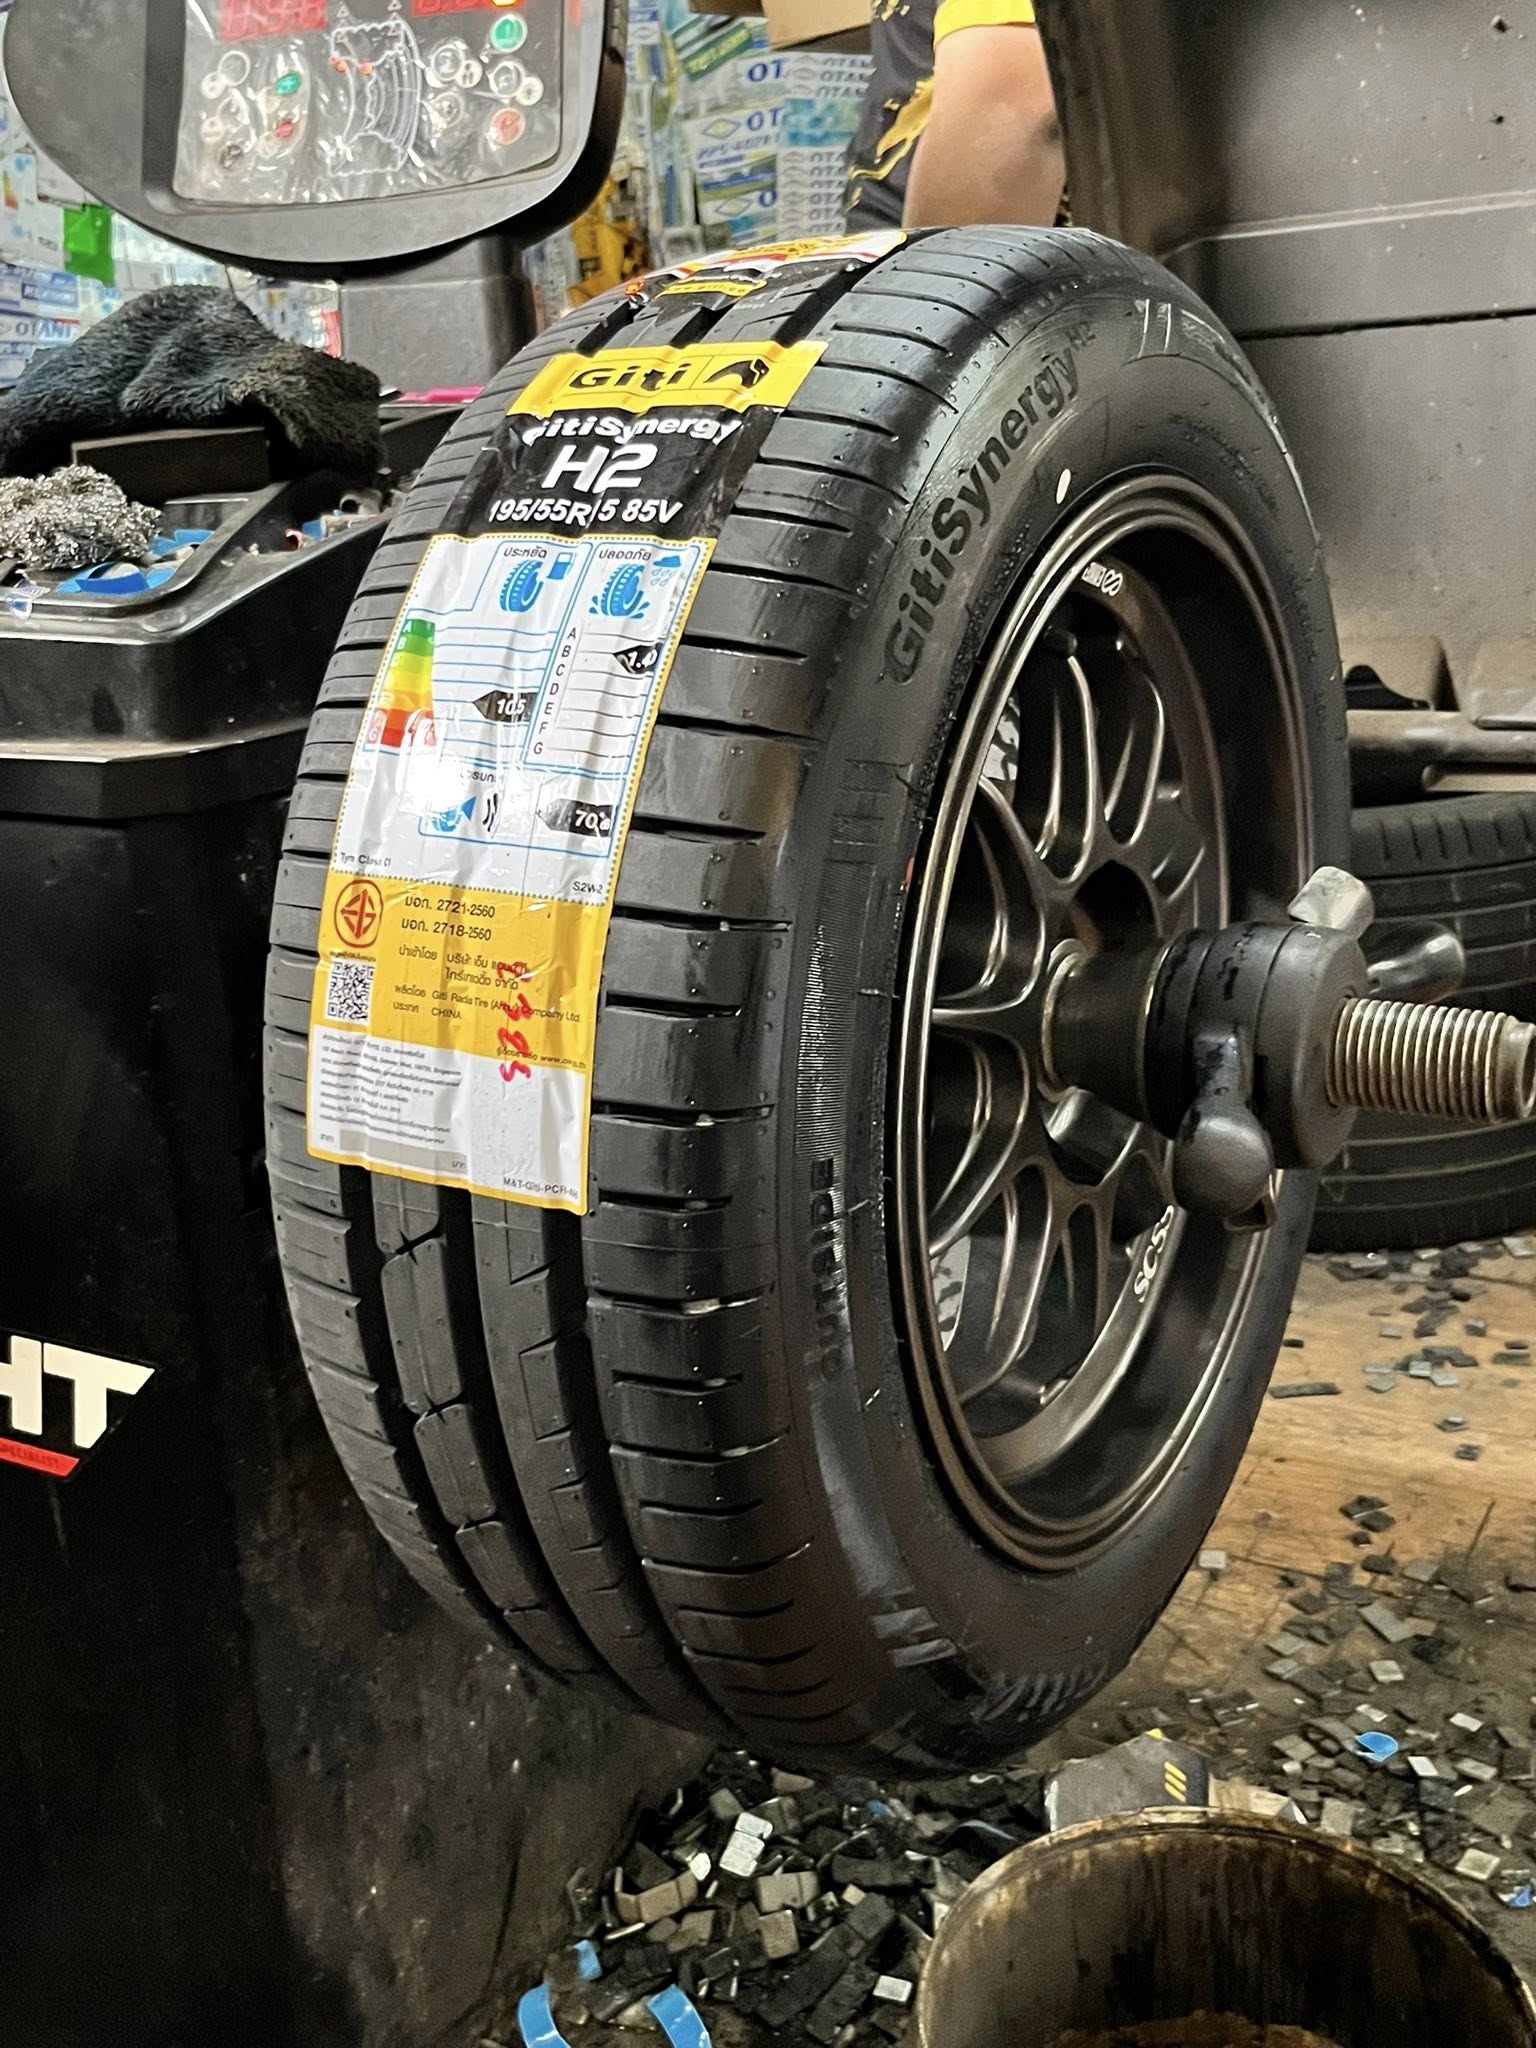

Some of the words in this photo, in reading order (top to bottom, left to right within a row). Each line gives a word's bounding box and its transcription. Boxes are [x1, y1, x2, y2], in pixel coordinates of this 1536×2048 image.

[569, 362, 690, 392] Giti
[541, 443, 658, 494] H2
[622, 500, 683, 526] 85V
[883, 349, 1079, 685] GitiSynergy
[503, 546, 548, 559] ประหยัด
[598, 548, 652, 562] ปลอดภัย
[567, 627, 577, 641] A
[561, 645, 571, 659] B
[555, 663, 565, 677] C
[548, 682, 560, 696] D
[543, 702, 554, 716] E
[538, 720, 549, 734] F
[532, 740, 544, 756] G
[574, 810, 599, 829] 70
[405, 896, 432, 910] มอก.
[437, 900, 496, 918] 2721-2560
[401, 918, 429, 933] มอก.
[433, 922, 492, 941] 2718-2560
[431, 1007, 462, 1020] CHINA
